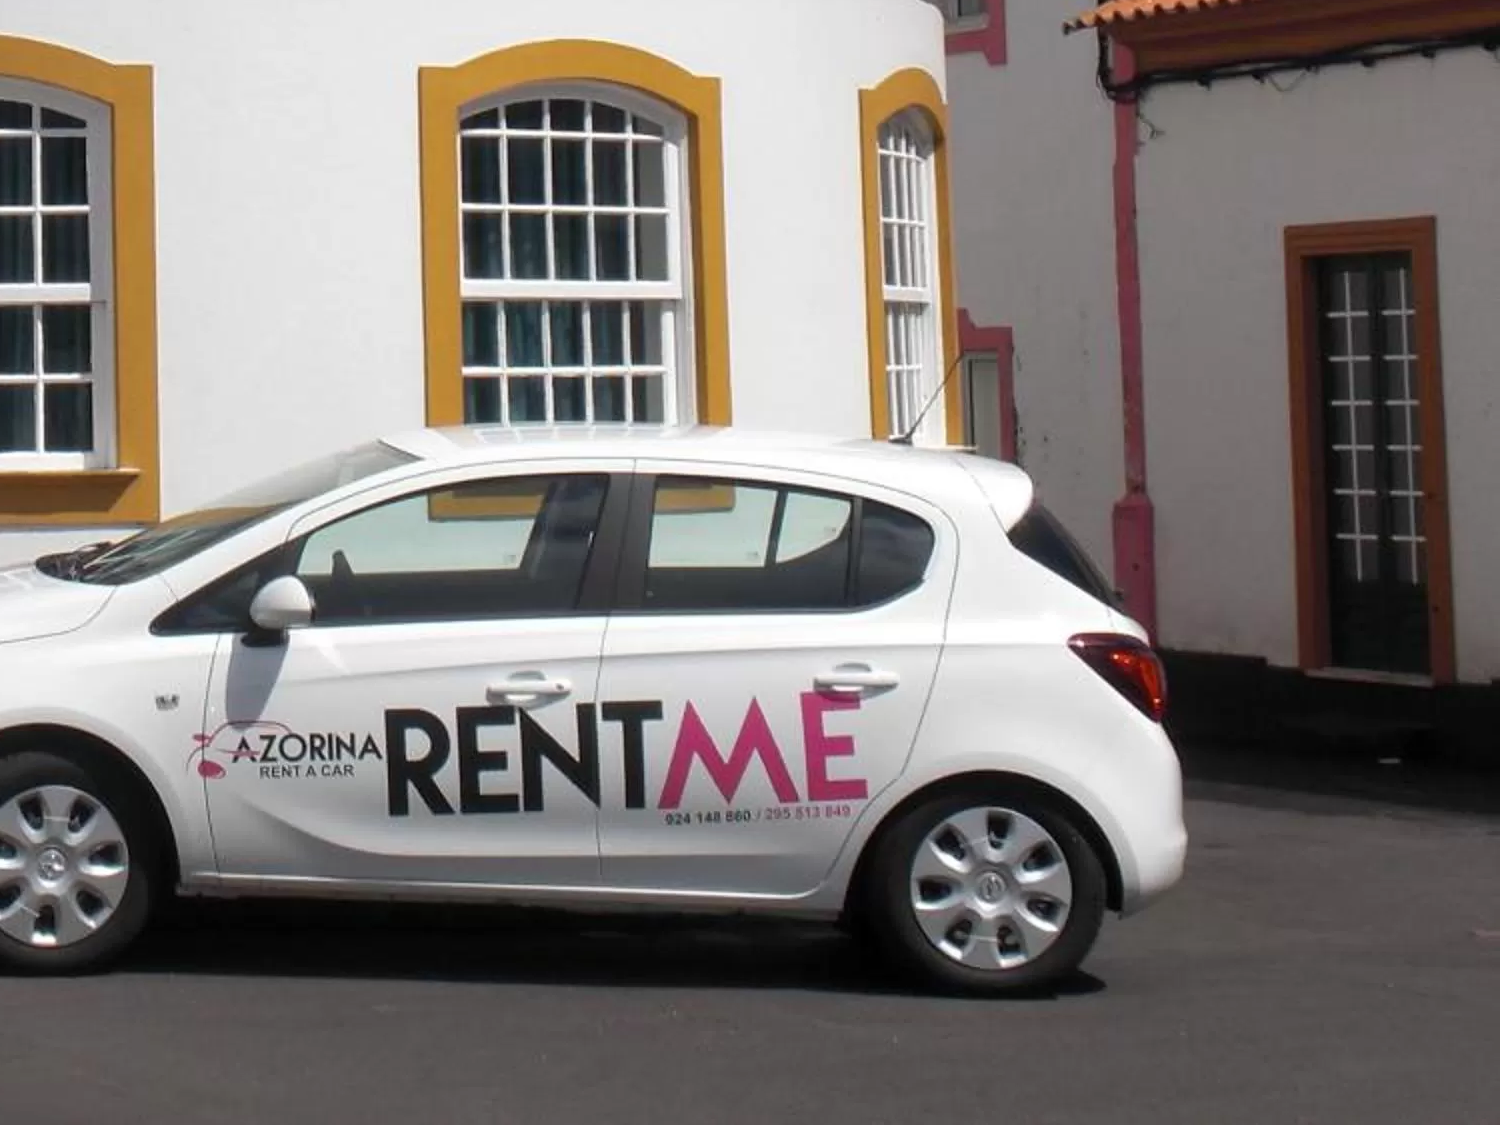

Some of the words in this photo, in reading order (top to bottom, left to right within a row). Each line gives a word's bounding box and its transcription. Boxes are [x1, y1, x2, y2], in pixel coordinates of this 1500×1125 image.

[231, 732, 383, 763] AZORINA
[259, 765, 300, 779] RENT
[305, 765, 317, 778] A
[321, 764, 355, 777] CAR
